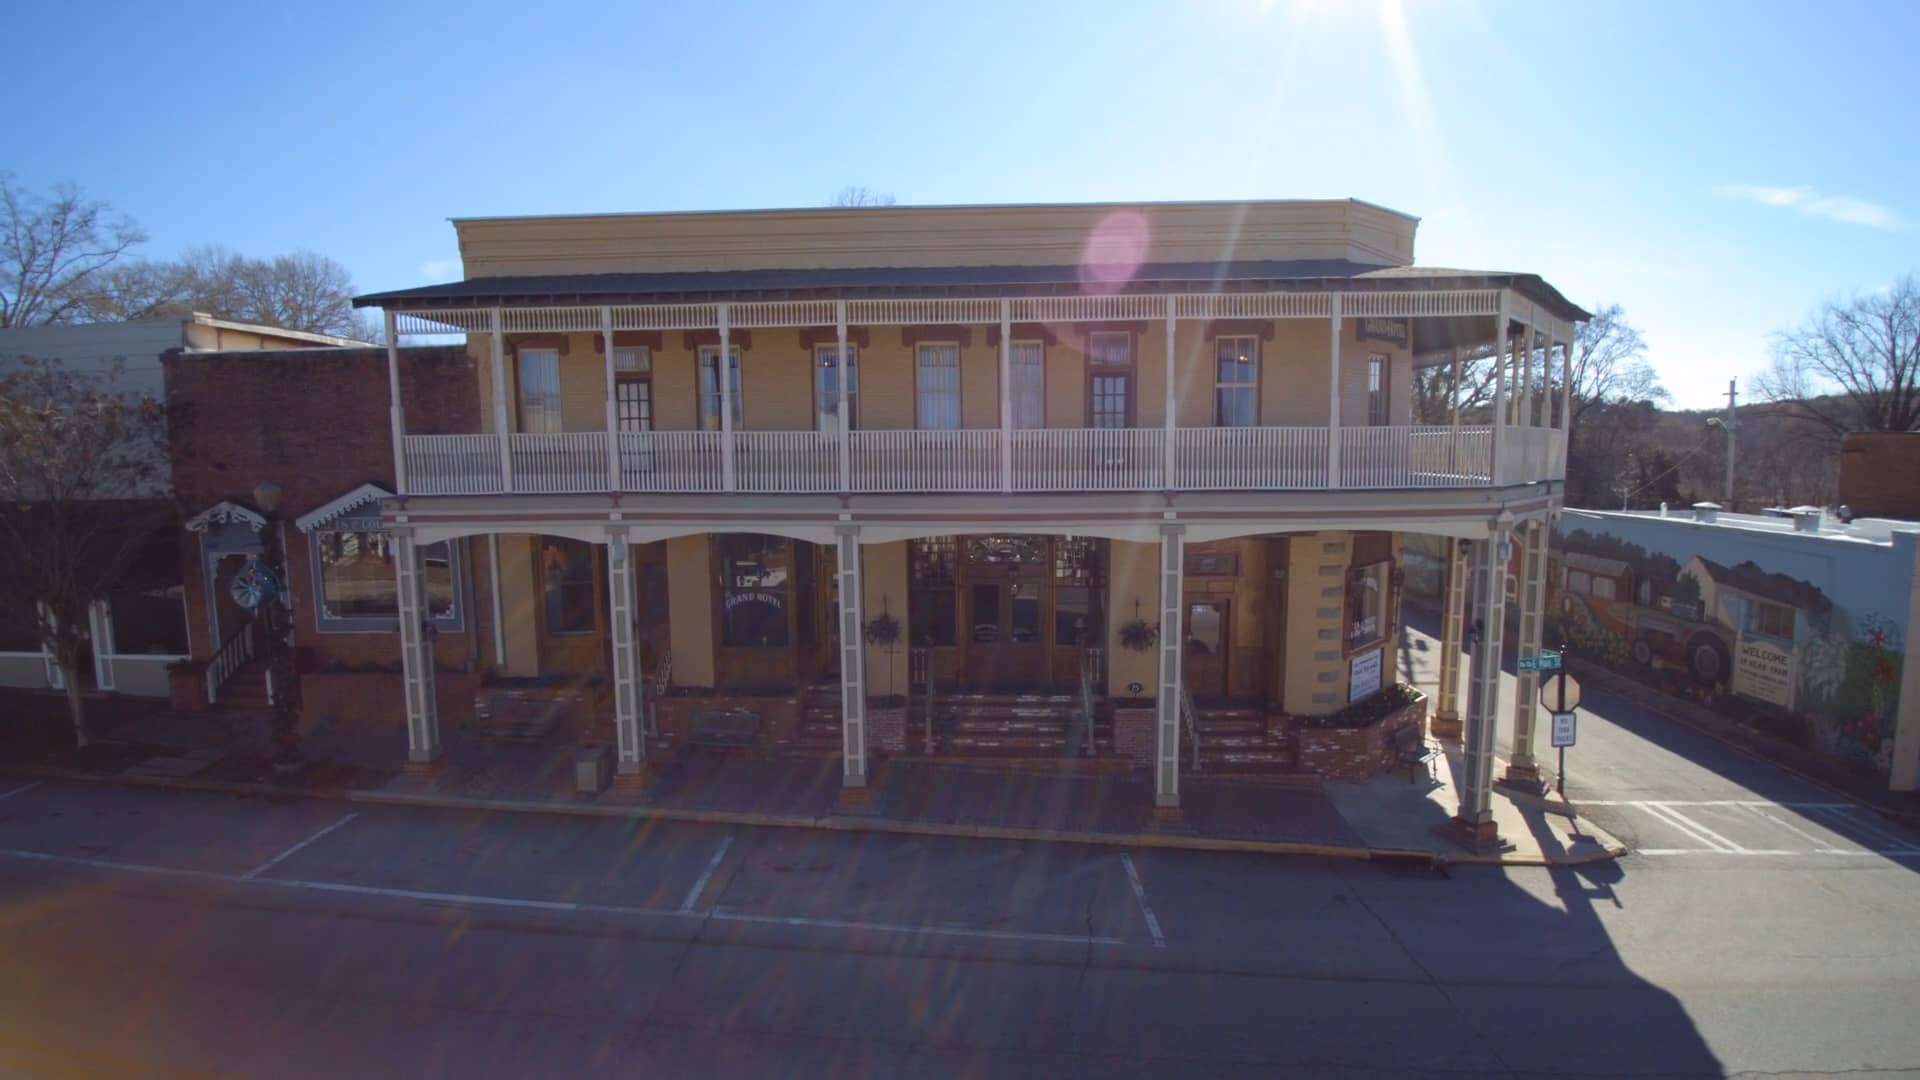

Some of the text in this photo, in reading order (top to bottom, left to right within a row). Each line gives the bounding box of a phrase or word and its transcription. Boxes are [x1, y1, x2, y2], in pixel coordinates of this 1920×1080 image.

[725, 592, 755, 608] GRAND
[756, 593, 782, 608] HOTEL
[1742, 647, 1787, 666] WELCOME
